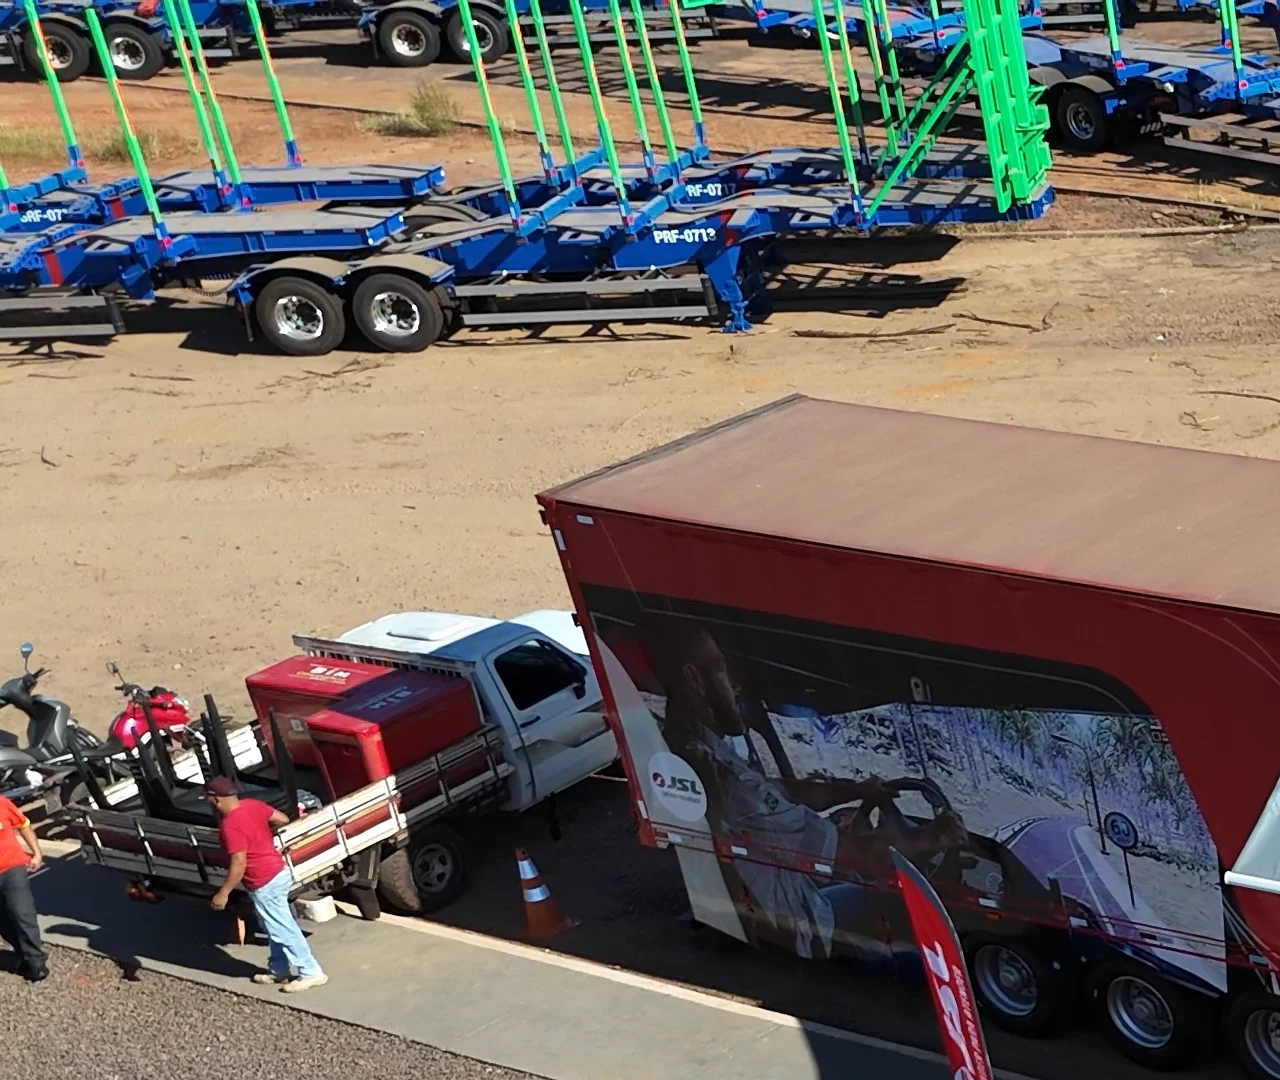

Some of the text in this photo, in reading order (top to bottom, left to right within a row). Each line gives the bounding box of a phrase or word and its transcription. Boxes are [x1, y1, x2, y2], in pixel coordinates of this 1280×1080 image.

[685, 182, 738, 198] RF-0717
[667, 775, 702, 796] JSL
[921, 940, 977, 1076] JSL
